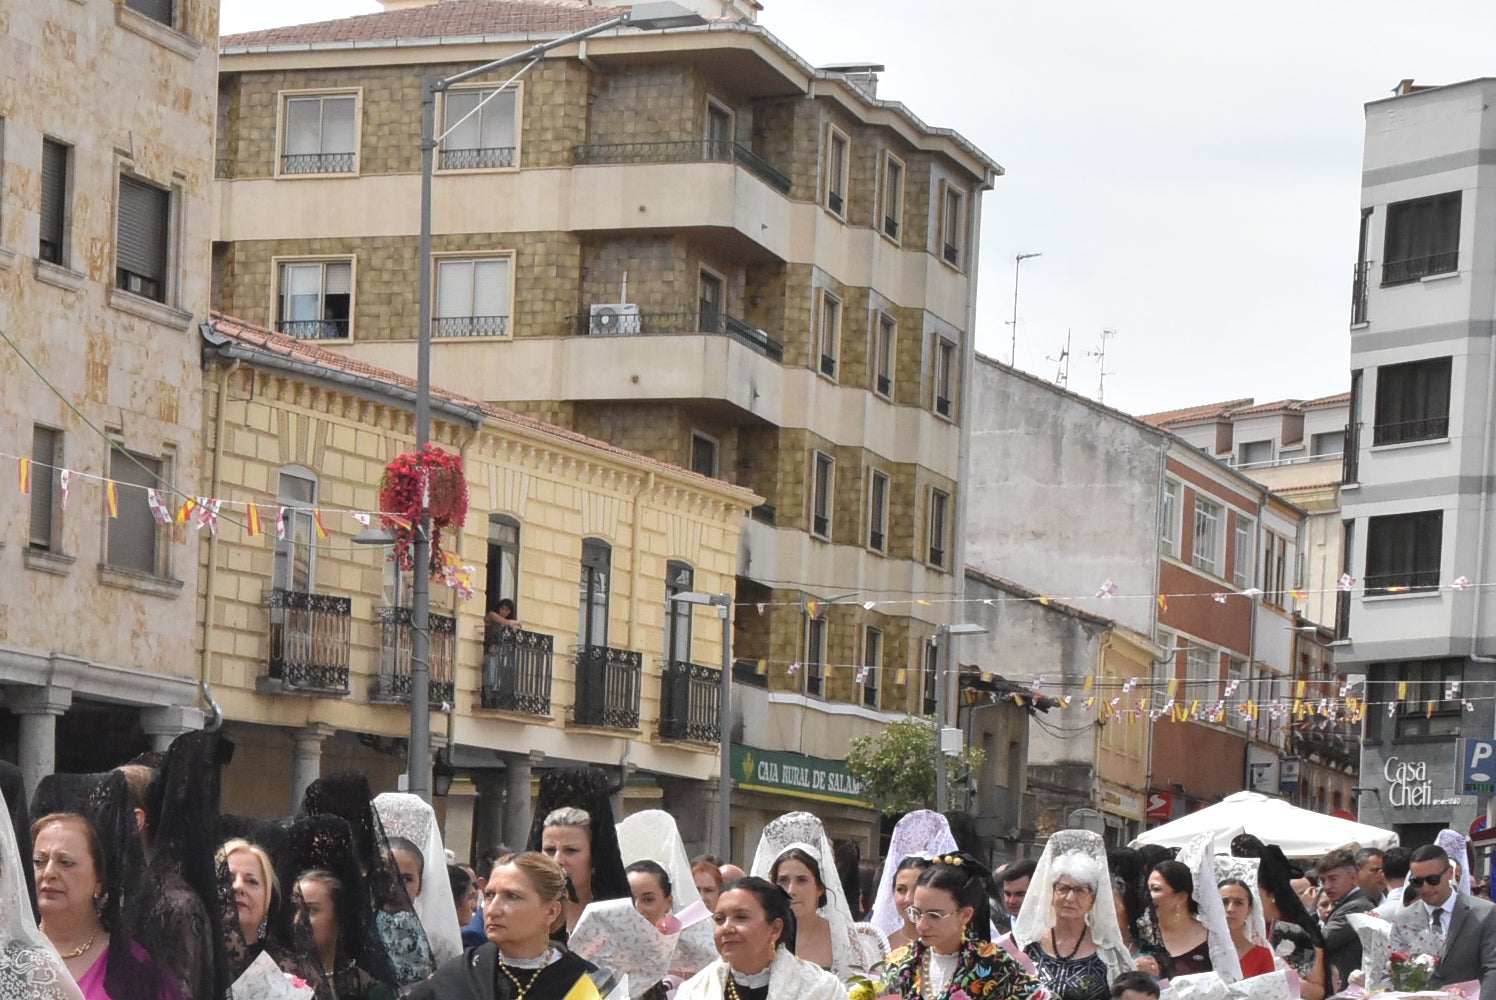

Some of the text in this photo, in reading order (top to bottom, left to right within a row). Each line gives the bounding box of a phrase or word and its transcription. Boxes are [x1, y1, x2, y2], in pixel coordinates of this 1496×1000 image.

[1470, 742, 1493, 768] P
[758, 760, 863, 795] CAJA RURAL DE SALAM
[1384, 756, 1426, 783] Casa
[1389, 779, 1432, 807] Cheti
